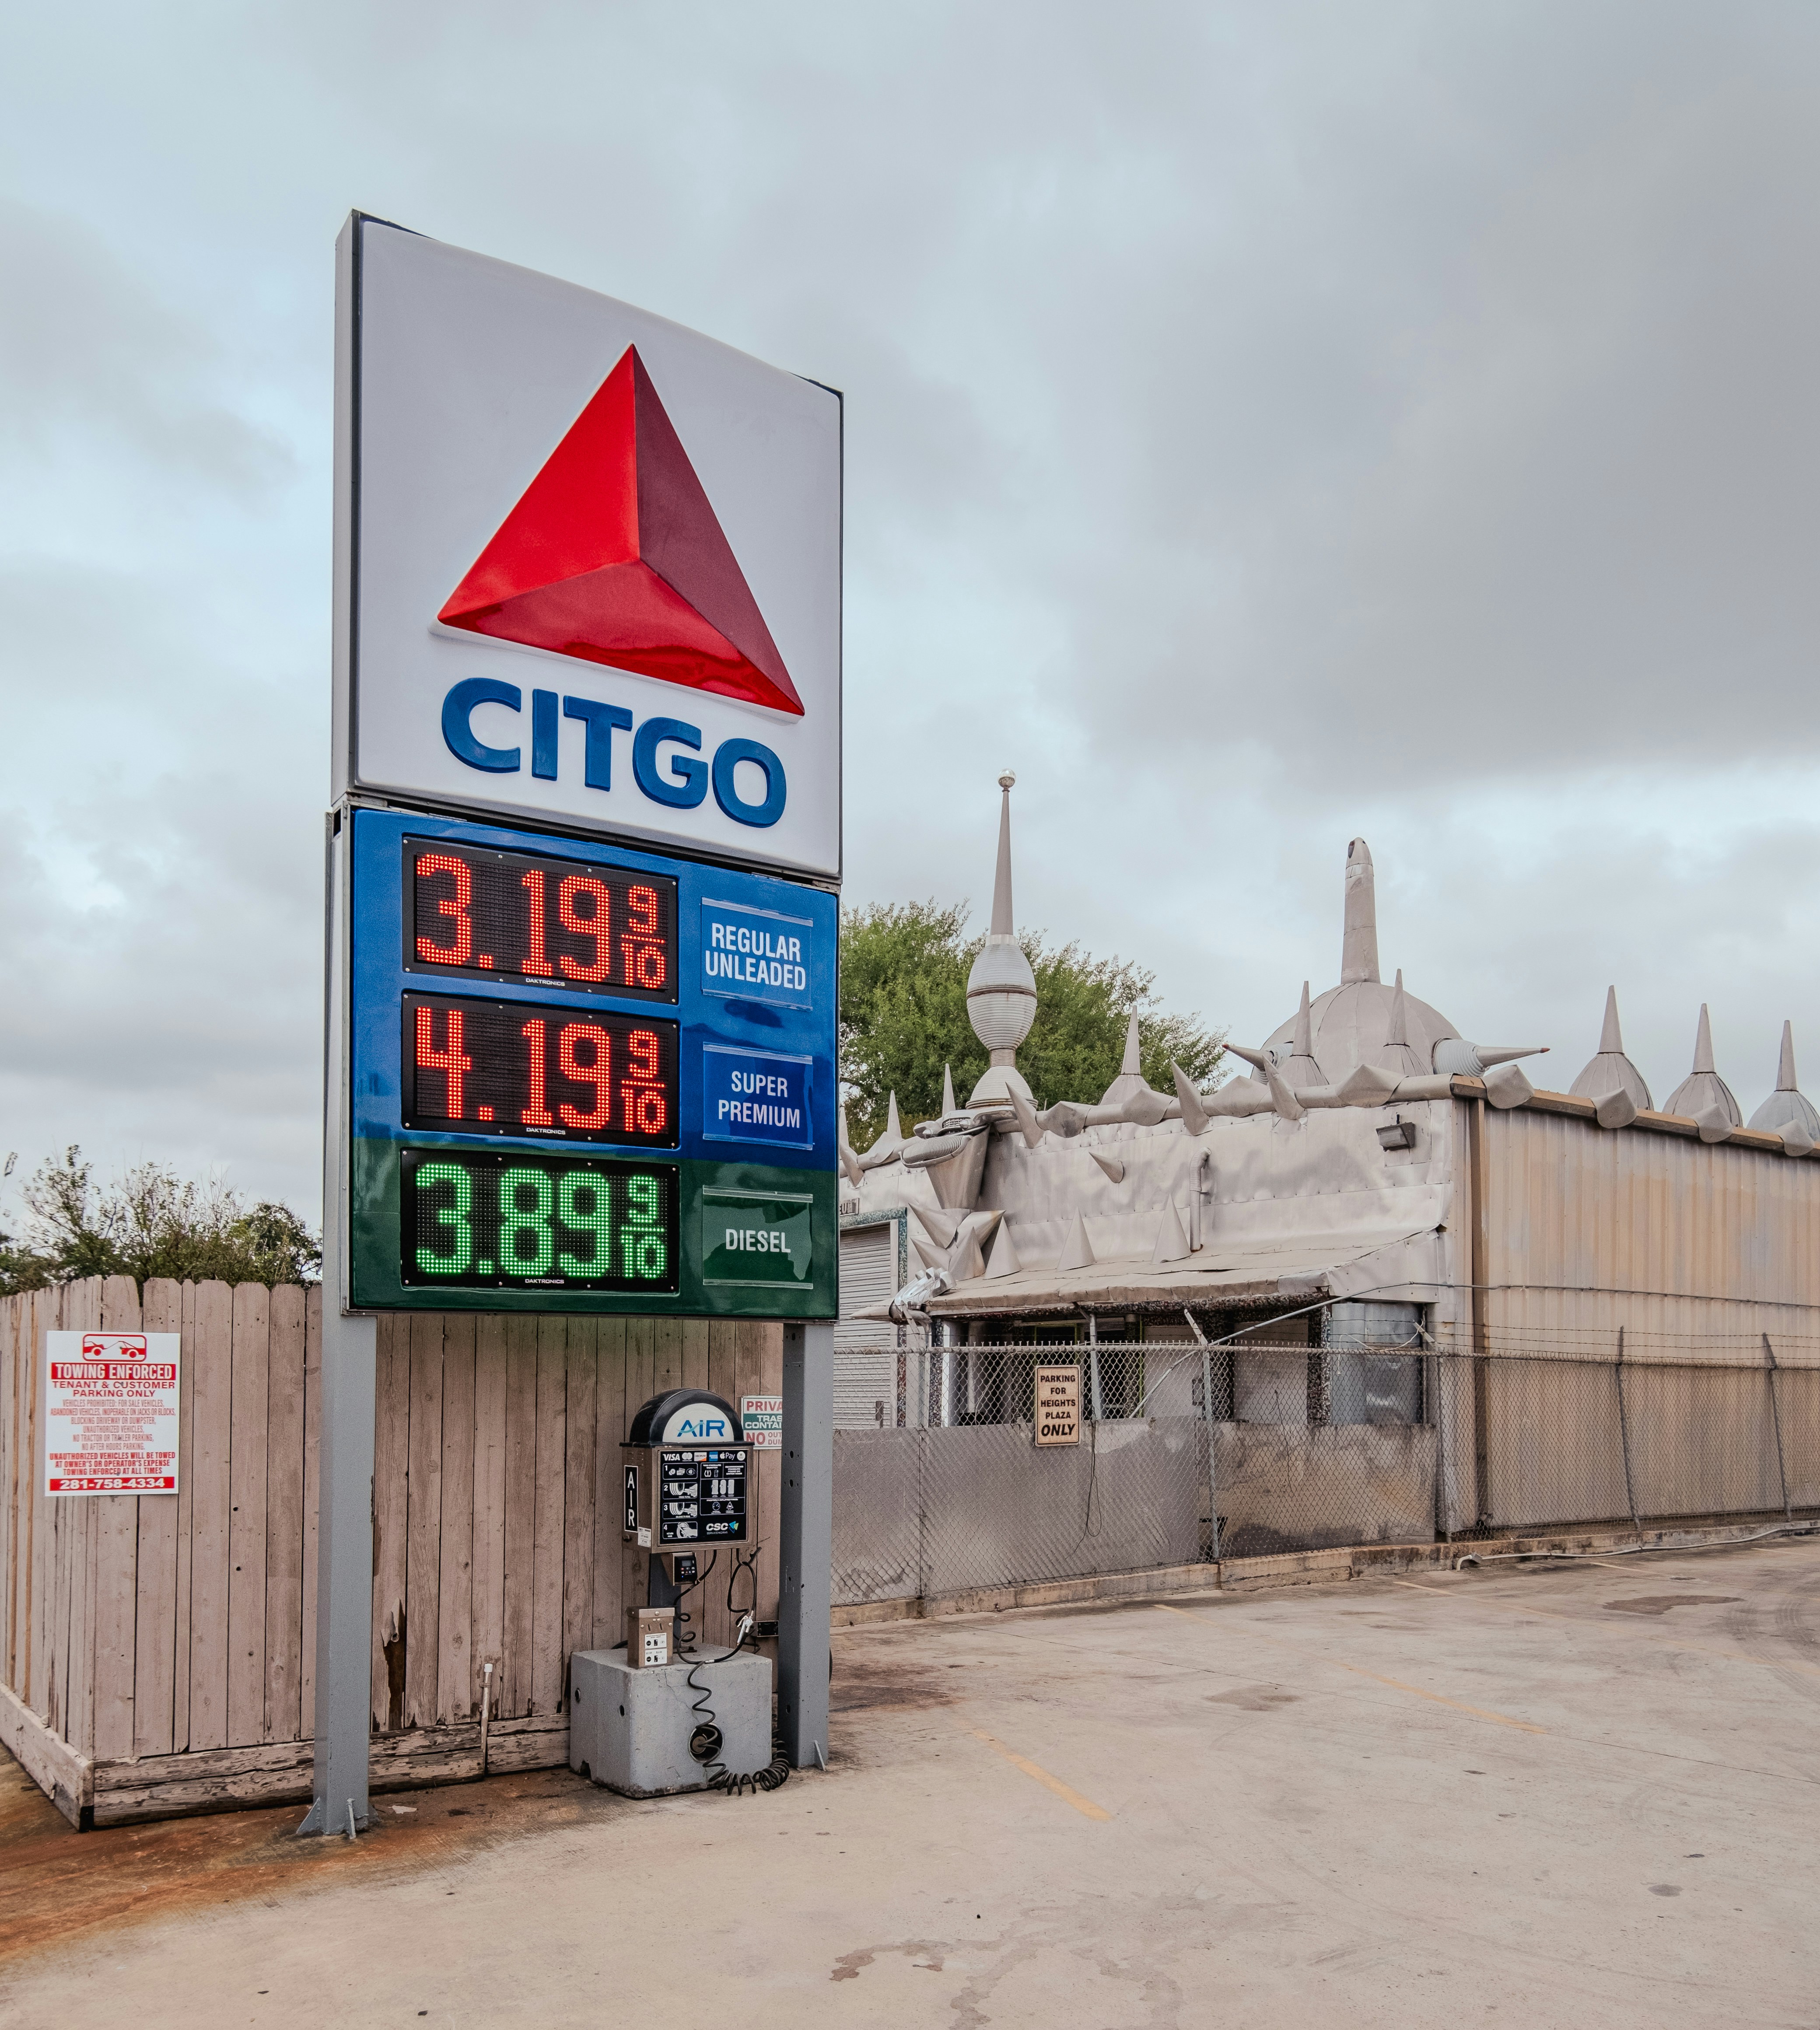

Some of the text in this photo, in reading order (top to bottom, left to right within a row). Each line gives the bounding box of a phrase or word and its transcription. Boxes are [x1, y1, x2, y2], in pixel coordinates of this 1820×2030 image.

[441, 677, 788, 828] CITGO
[416, 853, 657, 982] 3.19 9
[712, 923, 801, 962] REGULAR
[621, 942, 665, 989] 10
[705, 950, 806, 990] UNLEADED
[525, 978, 565, 987] DAKTRONICS
[416, 1006, 658, 1129] 4.19 9
[732, 1071, 788, 1098] SUPER
[621, 1088, 665, 1133] 10
[718, 1099, 800, 1128] PREMIUM
[526, 1127, 566, 1135] DAKTRONICS
[416, 1163, 657, 1277] 3.89 9
[726, 1228, 791, 1253] DIESEL
[621, 1233, 665, 1278] 10
[55, 1364, 172, 1379] TOWING ENFORCED
[1040, 1399, 1076, 1407] HEIGHTS
[1045, 1411, 1071, 1420] PLAZA
[746, 1432, 766, 1445] NO
[1041, 1424, 1076, 1437] ONLY
[725, 1452, 735, 1460] Pay
[60, 1478, 165, 1490] 281-758-4334
[706, 1522, 728, 1531] CSC
